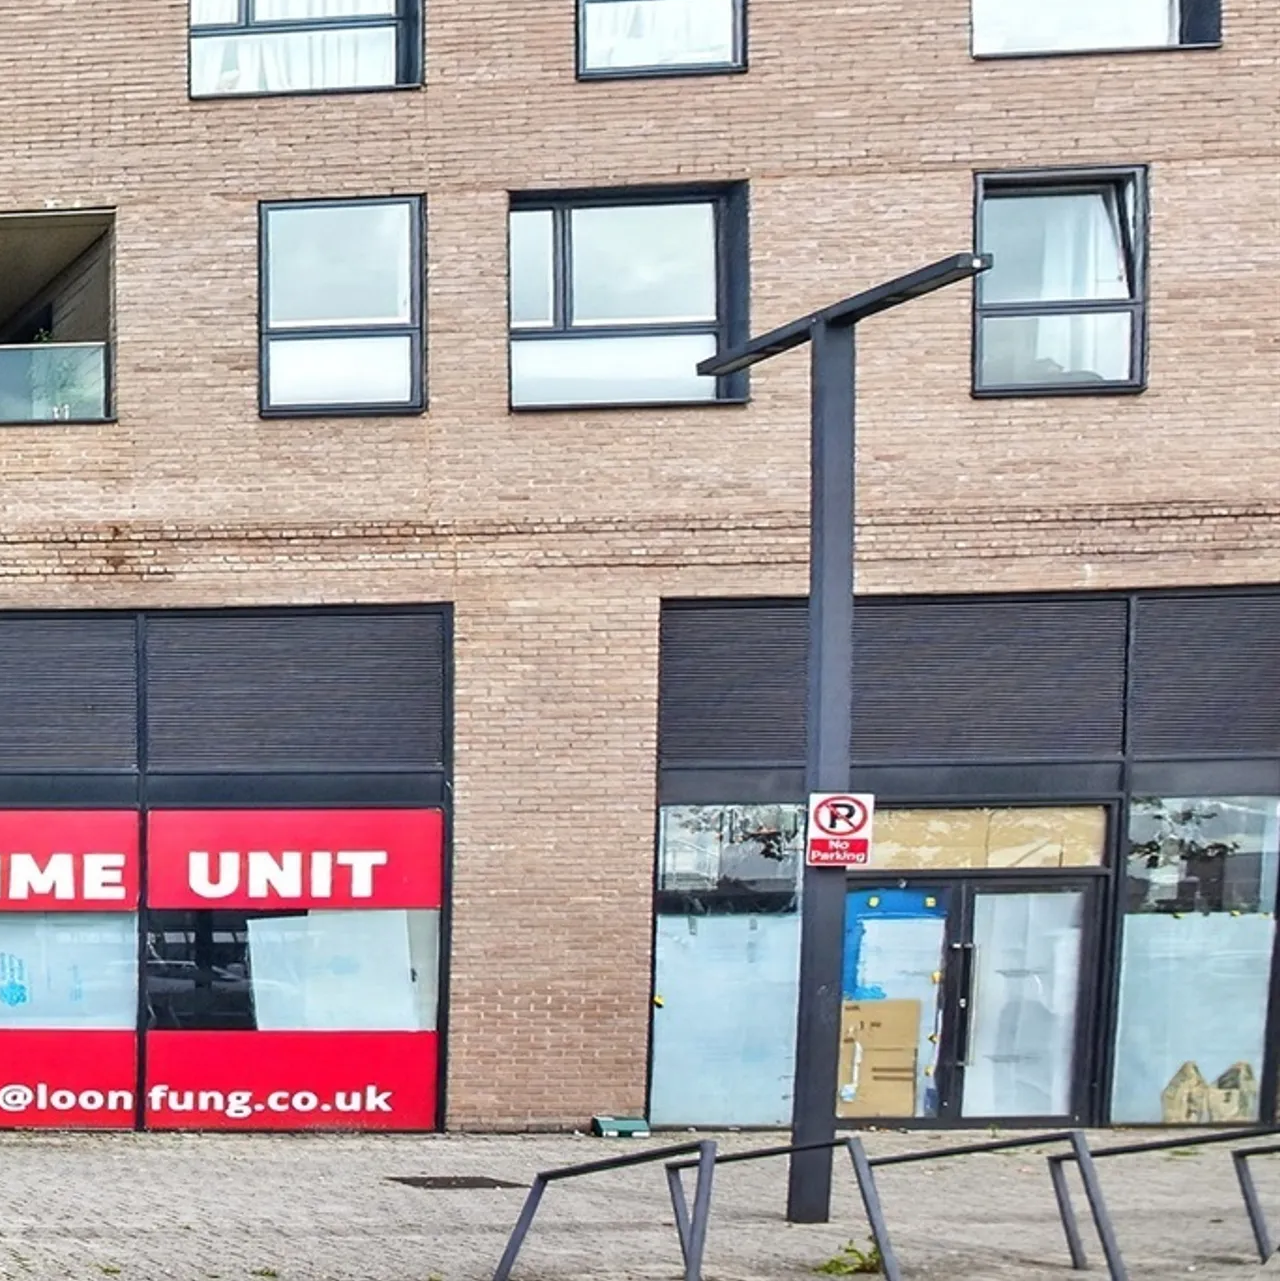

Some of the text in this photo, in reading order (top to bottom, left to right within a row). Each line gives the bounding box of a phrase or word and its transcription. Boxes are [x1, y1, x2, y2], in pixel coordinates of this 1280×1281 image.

[828, 840, 850, 850] No
[811, 850, 865, 862] Parking
[187, 850, 389, 898] UNIT
